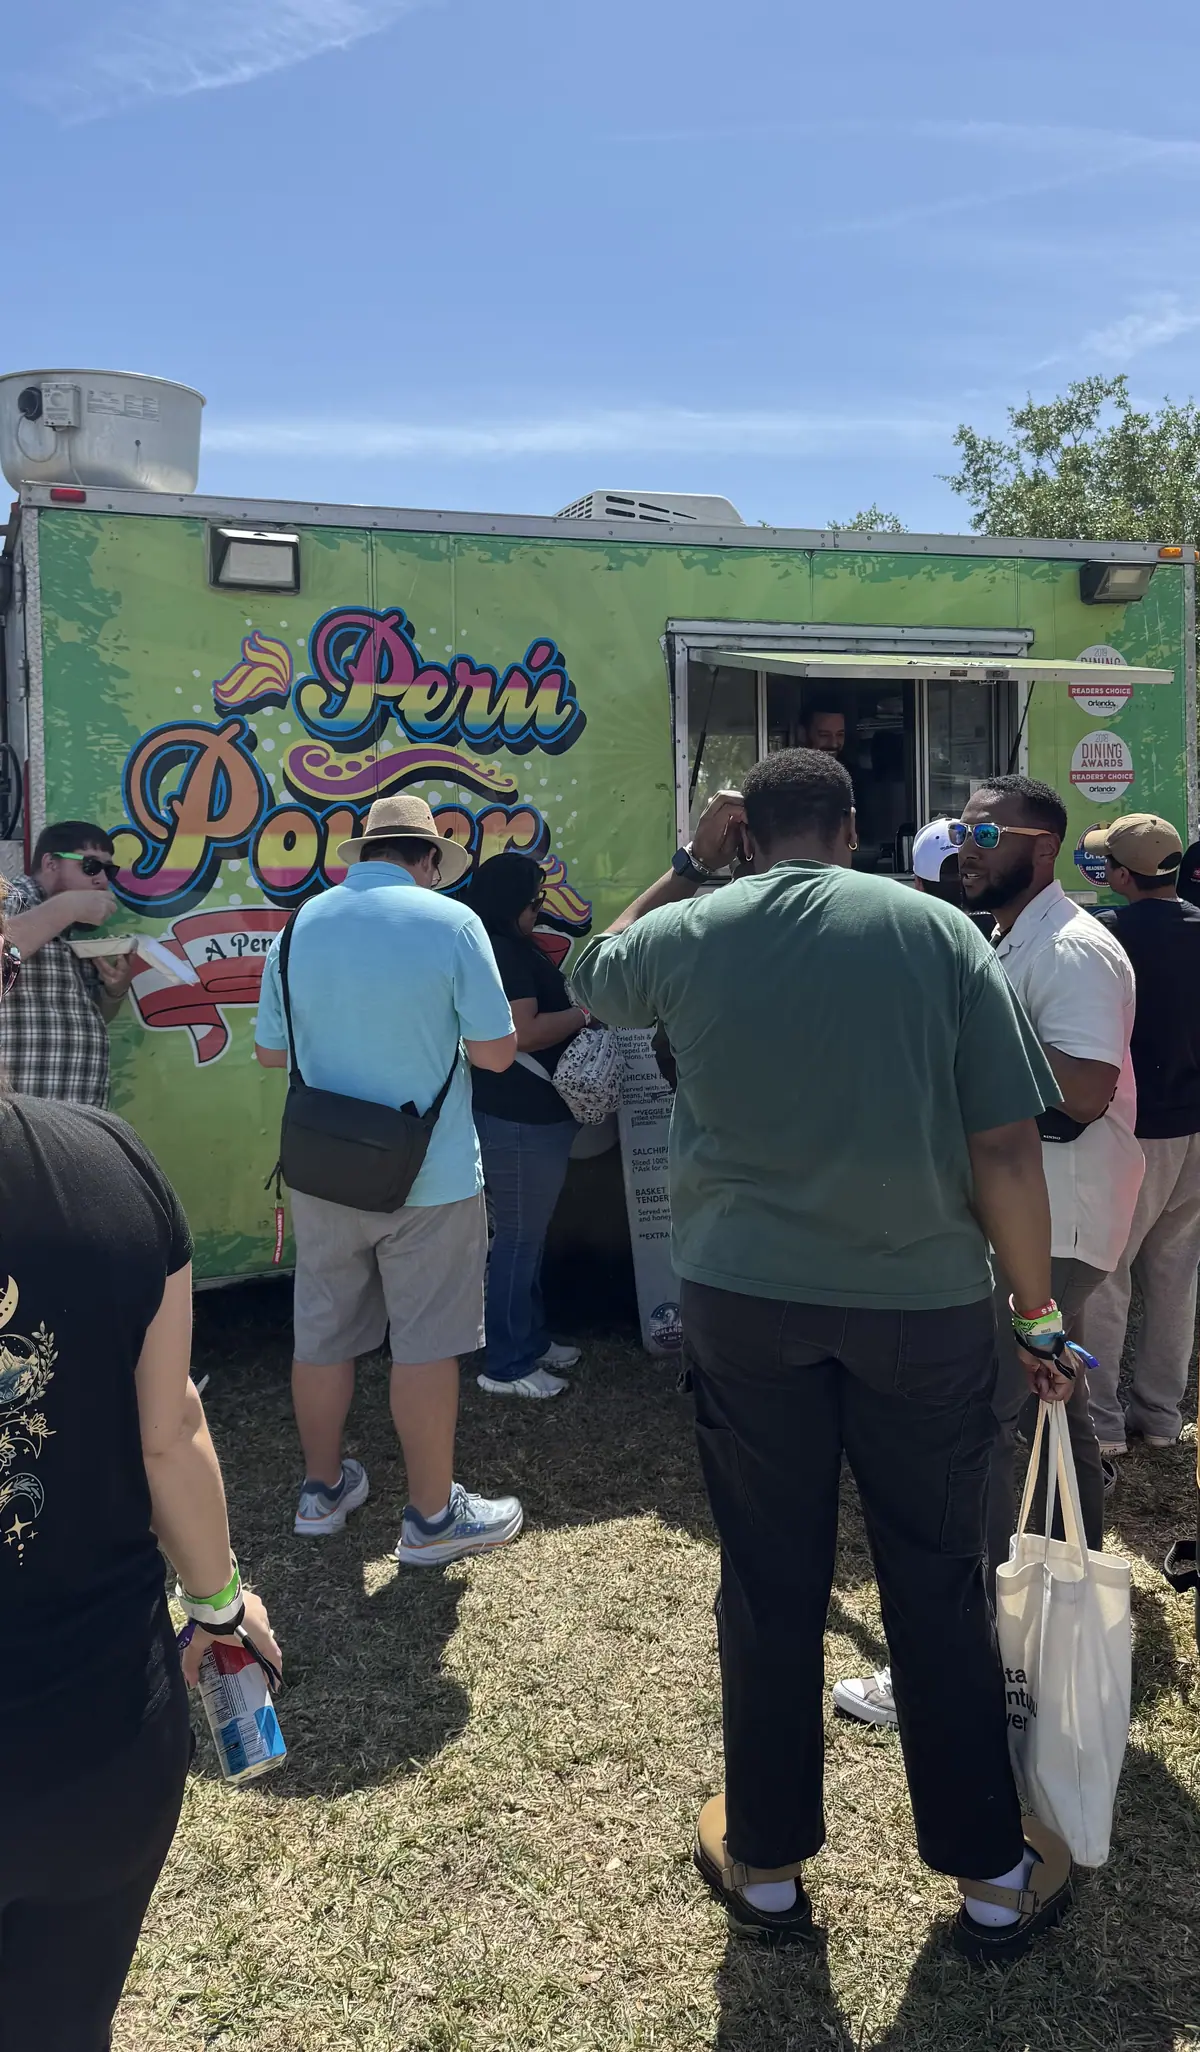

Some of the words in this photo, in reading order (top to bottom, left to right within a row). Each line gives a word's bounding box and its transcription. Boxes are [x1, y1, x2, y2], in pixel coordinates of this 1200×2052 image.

[1082, 743, 1122, 759] DINING
[1081, 759, 1123, 768] AWARDS
[1089, 785, 1116, 793] Orlando
[1095, 871, 1106, 879] 20
[205, 938, 227, 962] A
[635, 1187, 666, 1196] BASKET
[636, 1195, 669, 1204] TENDER
[638, 1208, 661, 1216] Served
